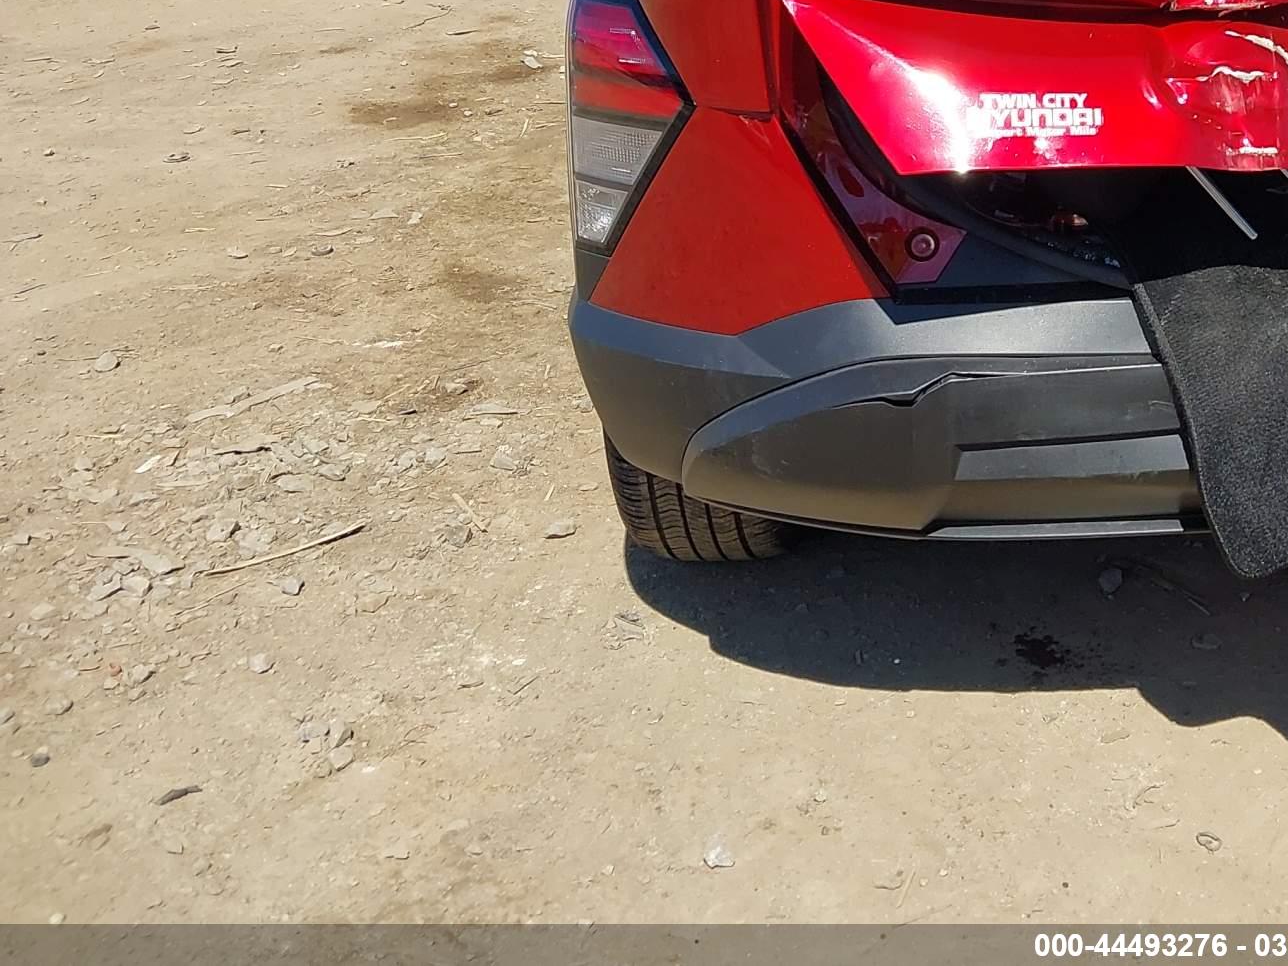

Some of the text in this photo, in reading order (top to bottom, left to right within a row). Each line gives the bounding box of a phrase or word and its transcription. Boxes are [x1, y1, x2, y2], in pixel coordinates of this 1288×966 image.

[979, 92, 1088, 109] TWIN CITY
[1025, 126, 1067, 138] Motor
[1070, 125, 1098, 137] Mile
